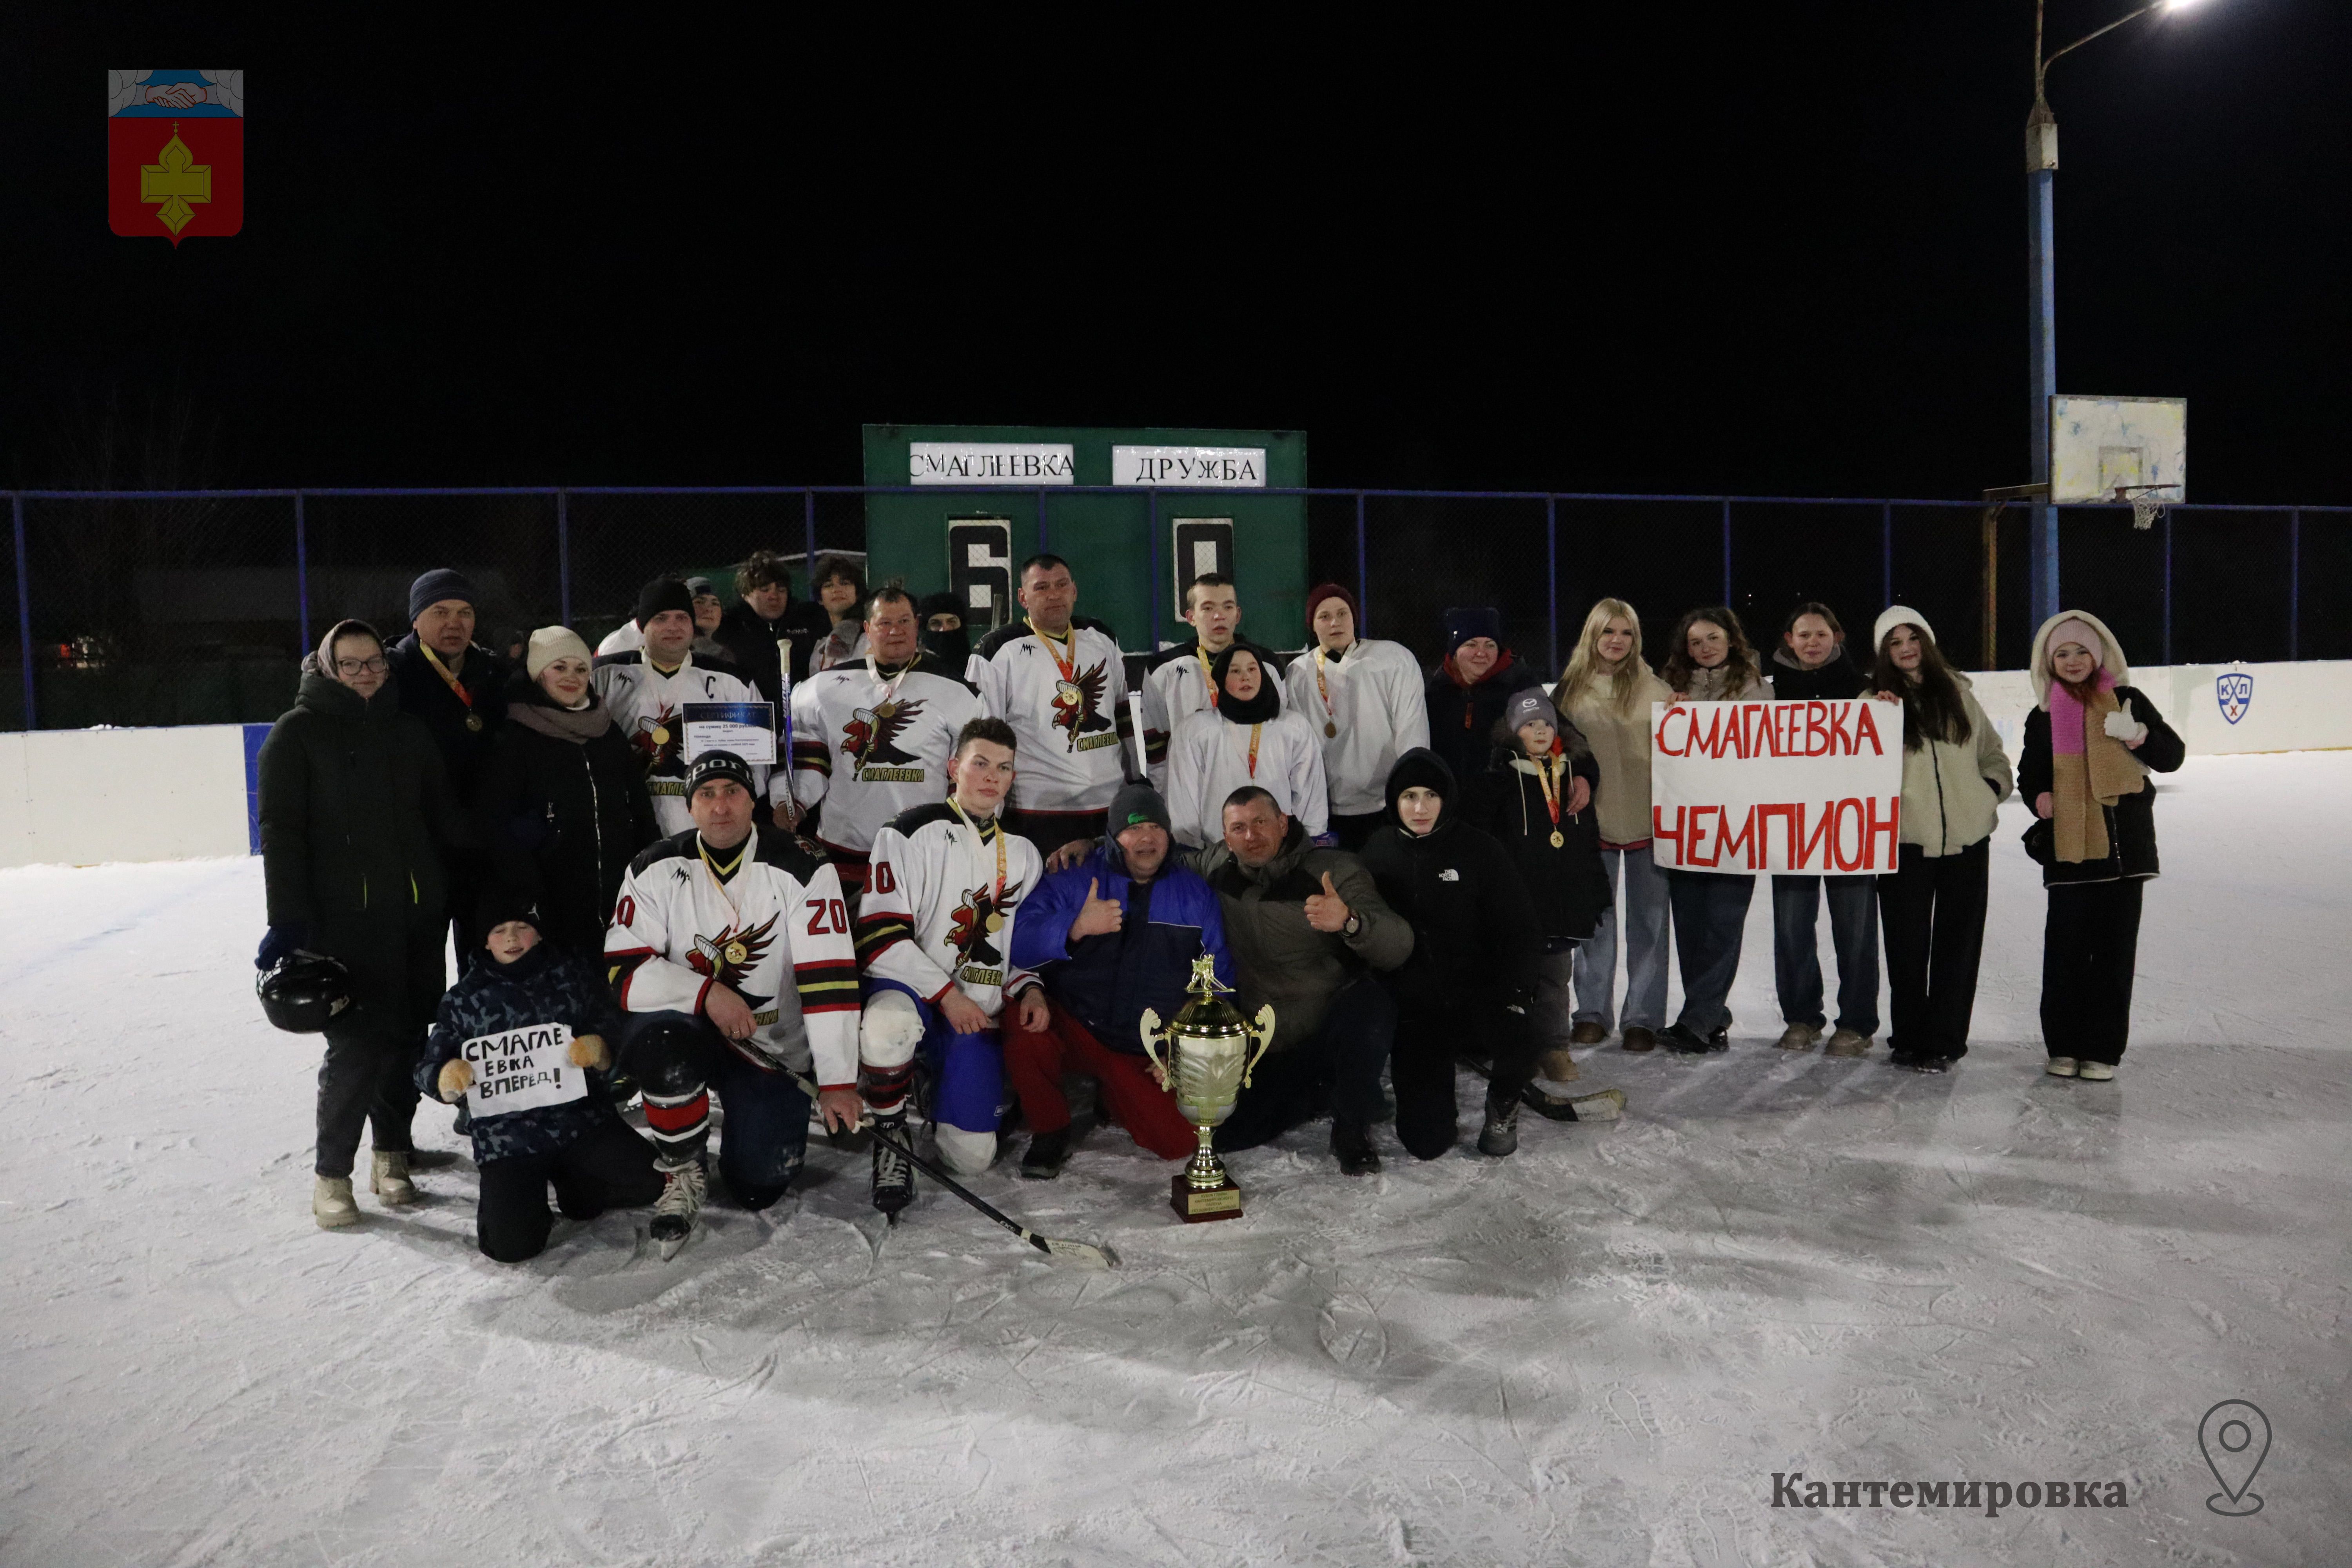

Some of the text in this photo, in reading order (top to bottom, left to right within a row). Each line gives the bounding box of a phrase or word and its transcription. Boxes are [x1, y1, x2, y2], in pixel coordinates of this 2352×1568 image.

[910, 454, 1074, 477] СМАГЛЕЕВКА
[1136, 457, 1257, 484] ДРУЖБА
[949, 525, 1010, 626] 6
[1655, 701, 1883, 759] СМАГЛЕЕВКА
[862, 768, 924, 782] СМАГЛЕЕВКА
[1653, 797, 1900, 872] ЧЕМПИОН
[806, 899, 848, 936] 20
[466, 1027, 564, 1062] СМАГЛЕ
[485, 1055, 534, 1078] ЕВКА
